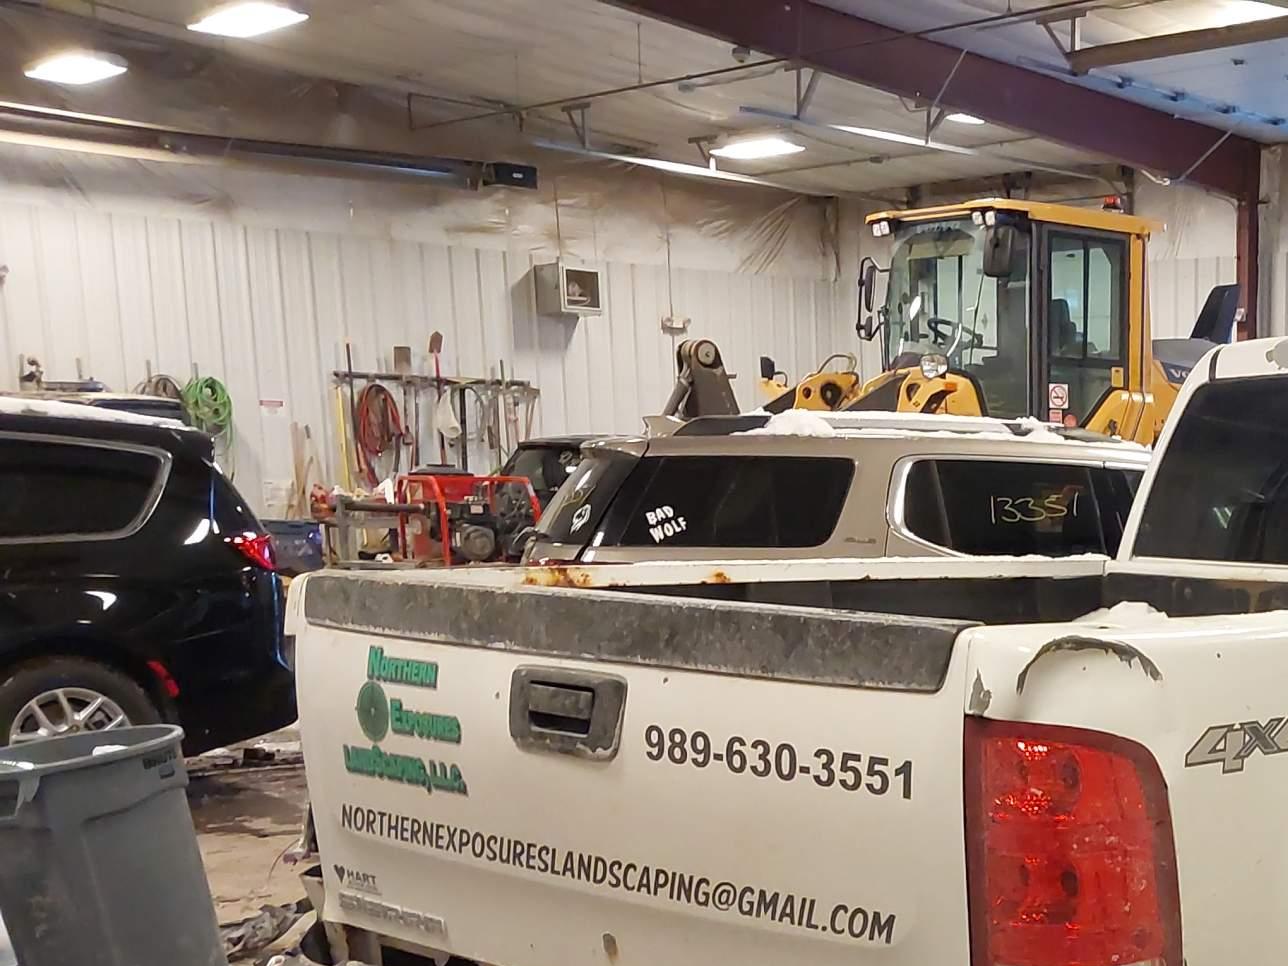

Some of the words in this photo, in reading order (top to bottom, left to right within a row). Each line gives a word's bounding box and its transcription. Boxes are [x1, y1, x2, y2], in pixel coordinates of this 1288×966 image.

[645, 505, 674, 526] BAD
[990, 491, 1079, 524] 13351
[648, 516, 687, 544] WOLF
[645, 724, 913, 800] 989-630-3551
[341, 803, 897, 945] NORTHERNEXPOSURESLANDSCAPING@GMAIL.COM
[346, 868, 376, 886] HART
